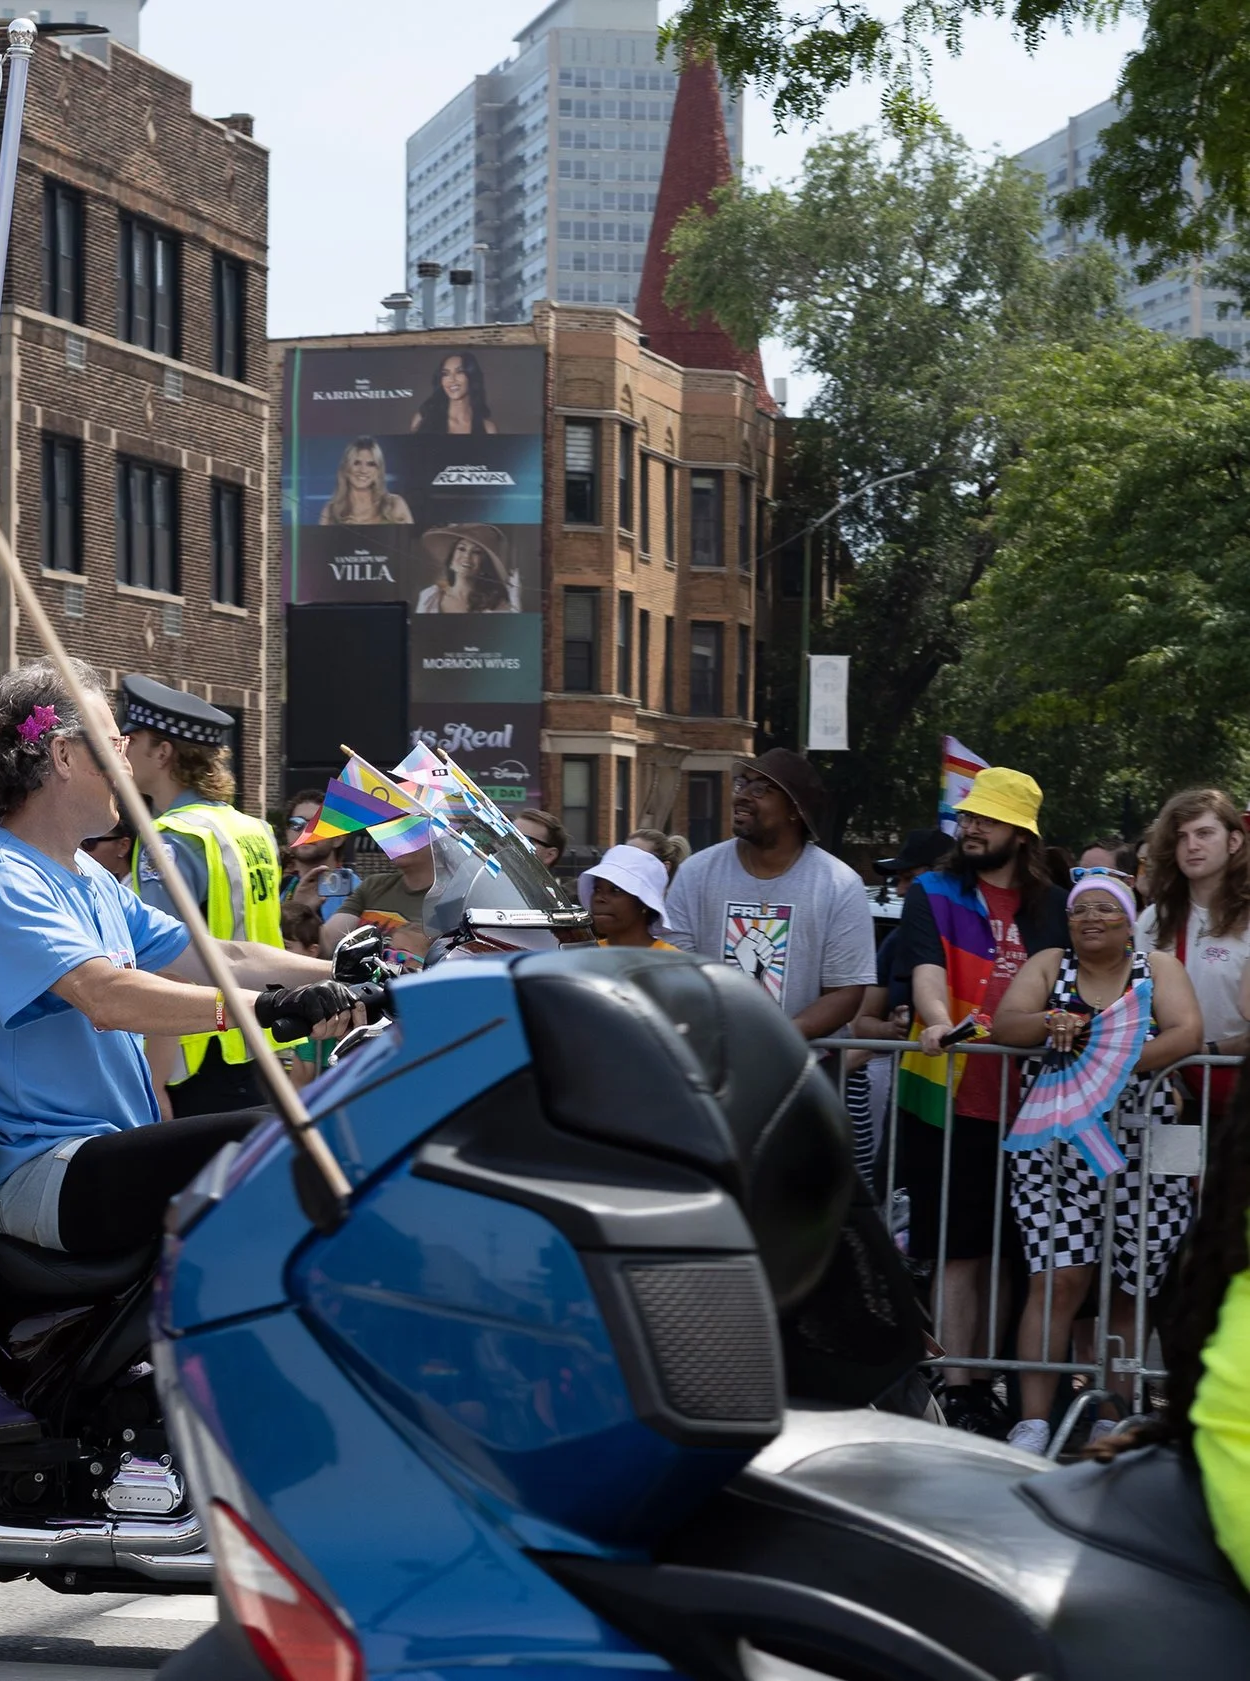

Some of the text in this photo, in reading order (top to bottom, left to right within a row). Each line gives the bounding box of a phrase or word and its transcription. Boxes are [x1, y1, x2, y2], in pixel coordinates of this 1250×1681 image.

[312, 389, 414, 401] KARDASHIANS
[435, 472, 510, 484] RUNWAY
[327, 563, 397, 583] VILLA
[422, 658, 521, 669] MORMON WIVES
[437, 722, 514, 753] Real
[499, 788, 523, 798] DAY
[215, 1001, 225, 1026] PRIDE
